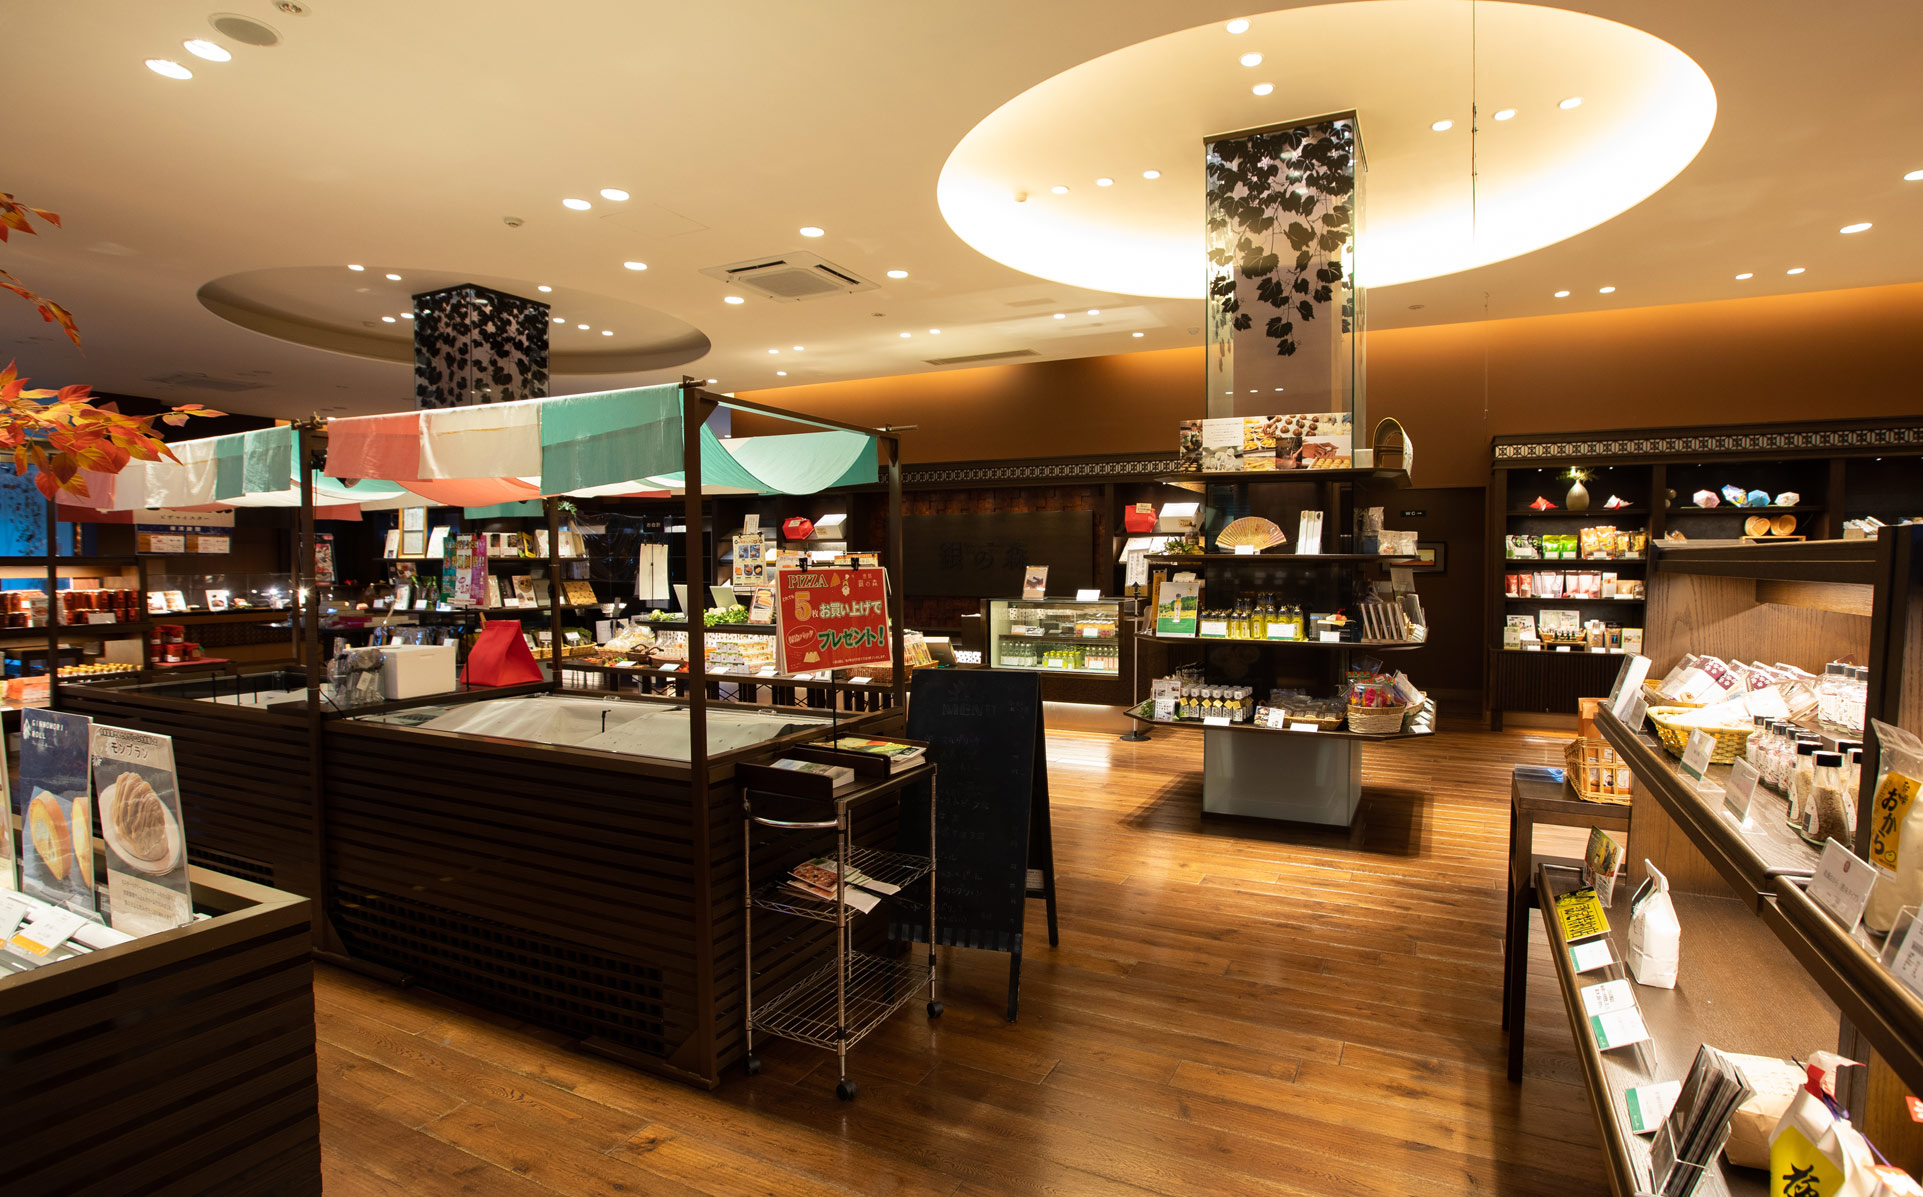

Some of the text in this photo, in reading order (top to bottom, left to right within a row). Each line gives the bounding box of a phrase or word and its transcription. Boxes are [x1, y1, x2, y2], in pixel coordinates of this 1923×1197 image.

[787, 574, 829, 589] PIZZA
[817, 625, 885, 651] プレゼント!
[110, 741, 150, 759] モンブラン
[1874, 787, 1898, 855] おから
